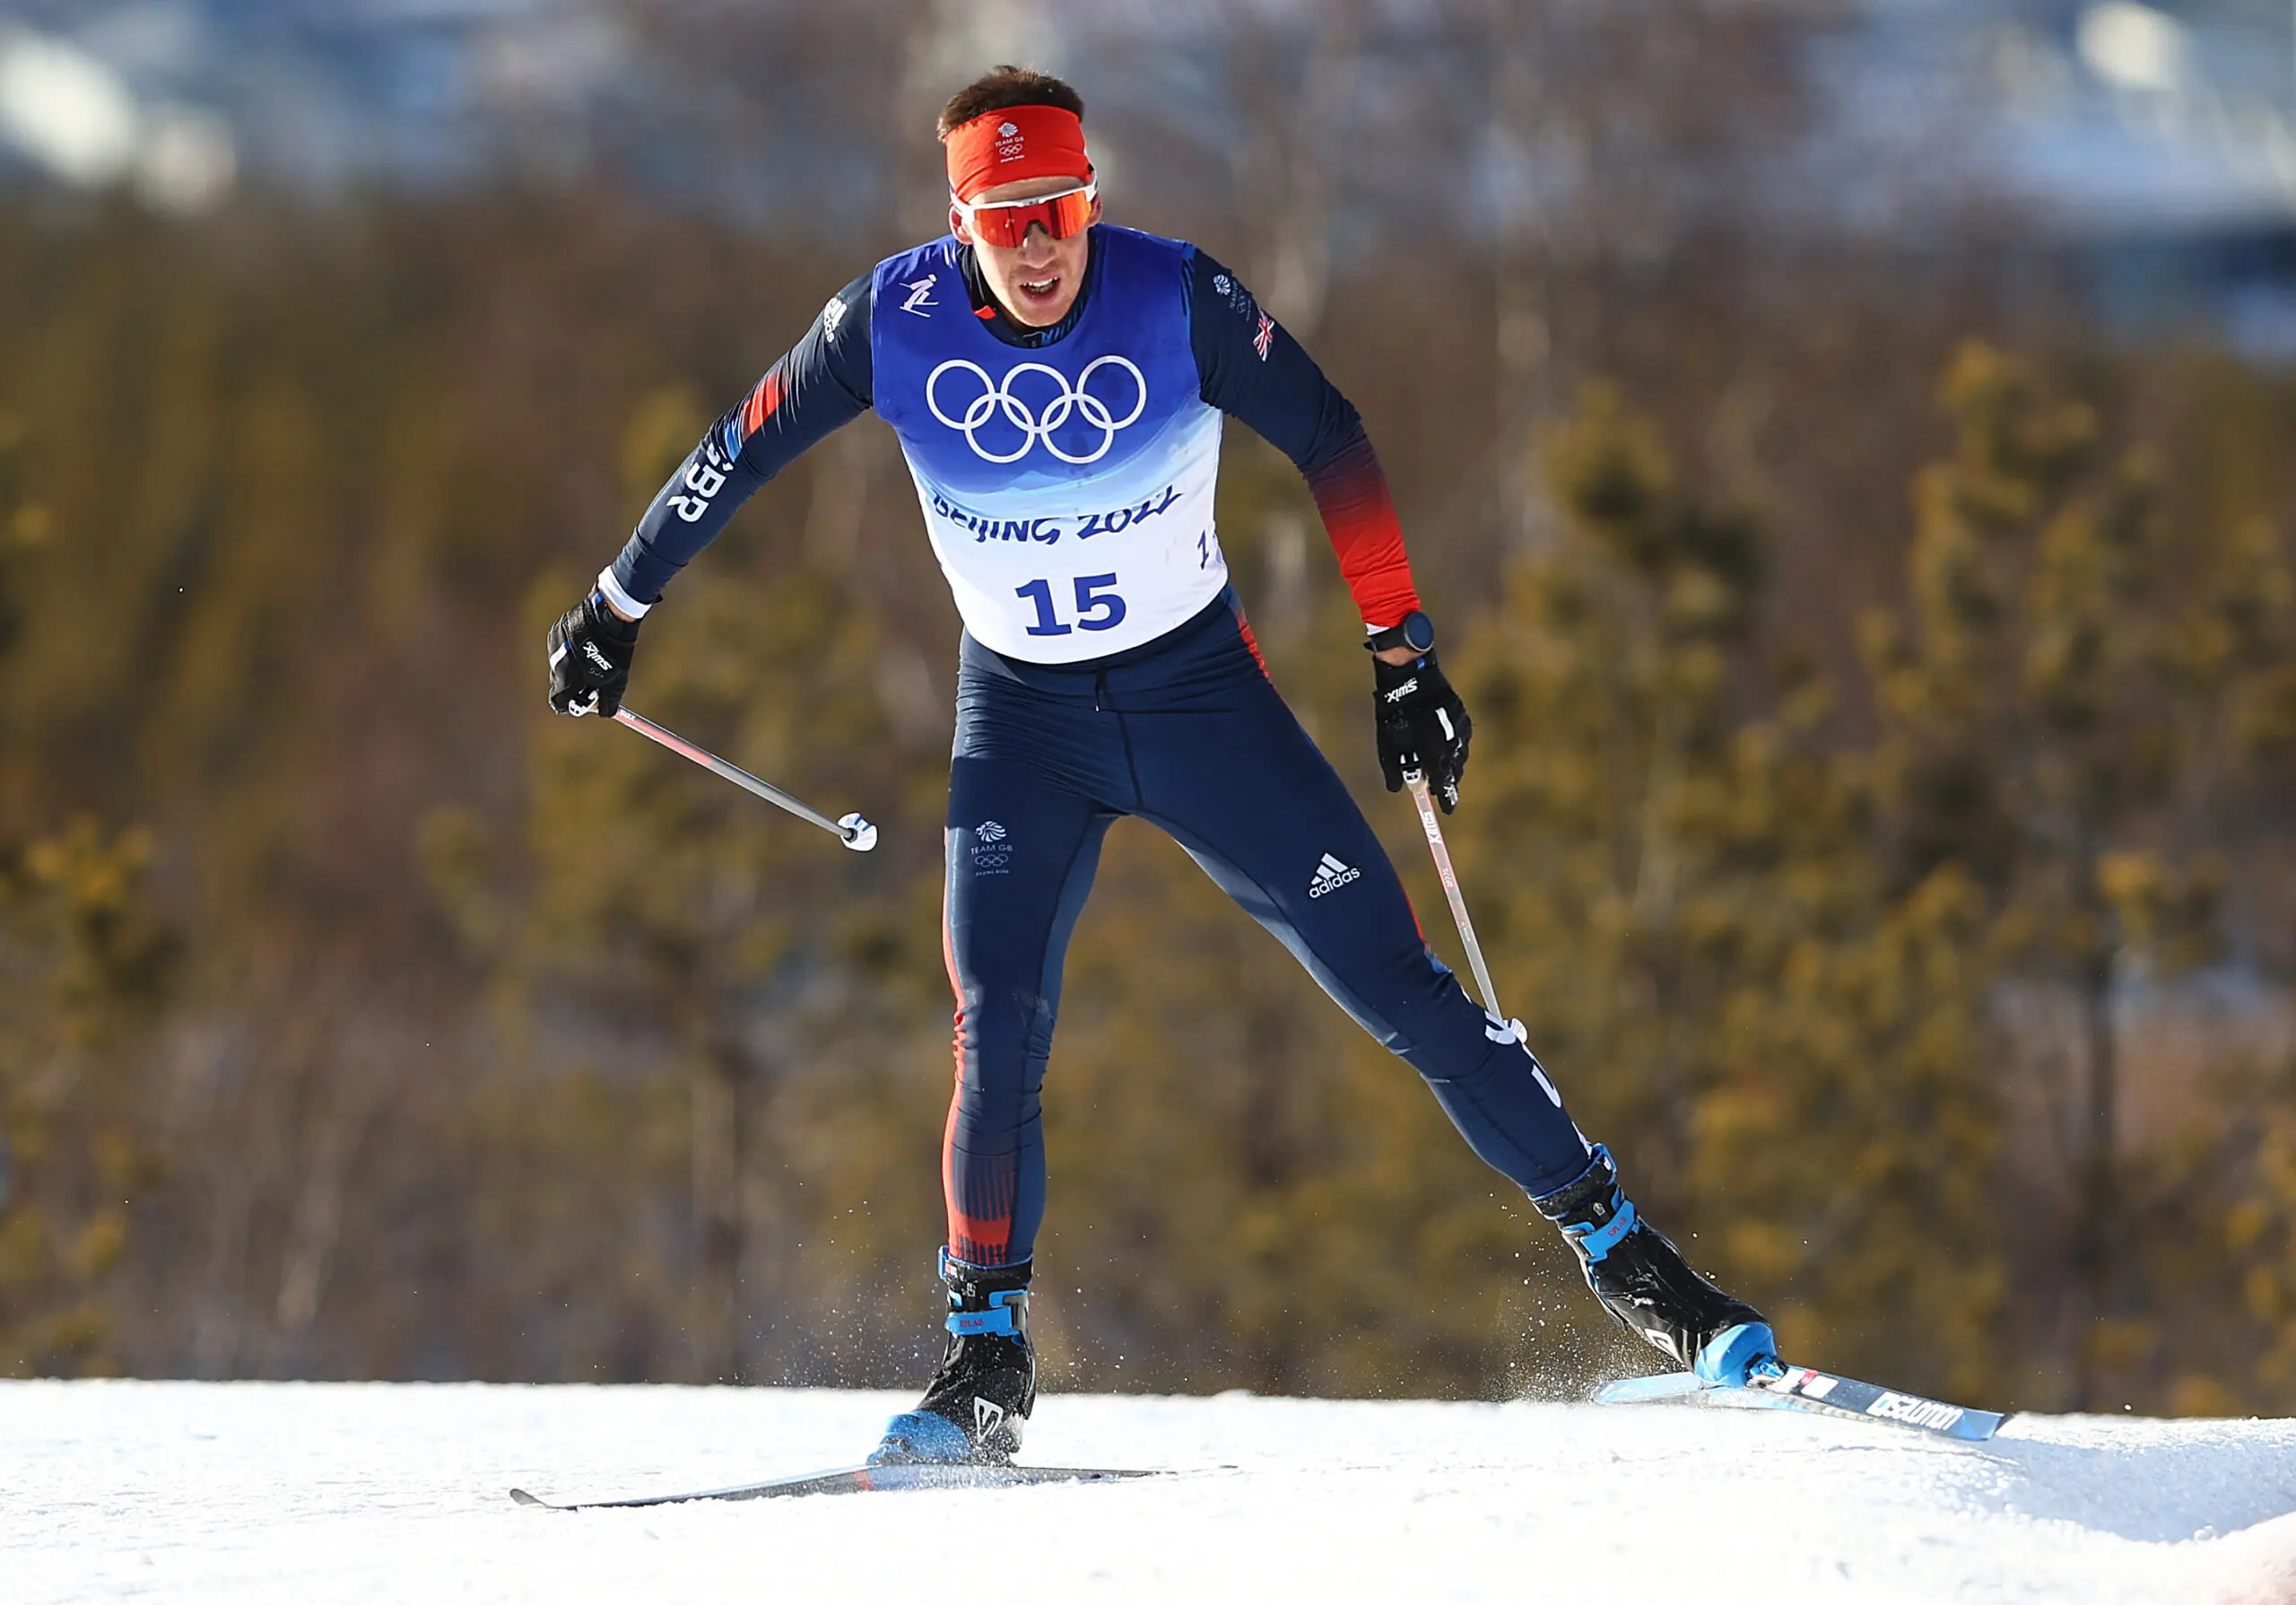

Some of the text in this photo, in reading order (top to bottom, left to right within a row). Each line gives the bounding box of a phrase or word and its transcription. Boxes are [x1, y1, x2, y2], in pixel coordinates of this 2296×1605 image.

[1014, 572, 1127, 636] 15
[970, 844, 1013, 855] TEAM GB
[1309, 868, 1361, 899] adidas
